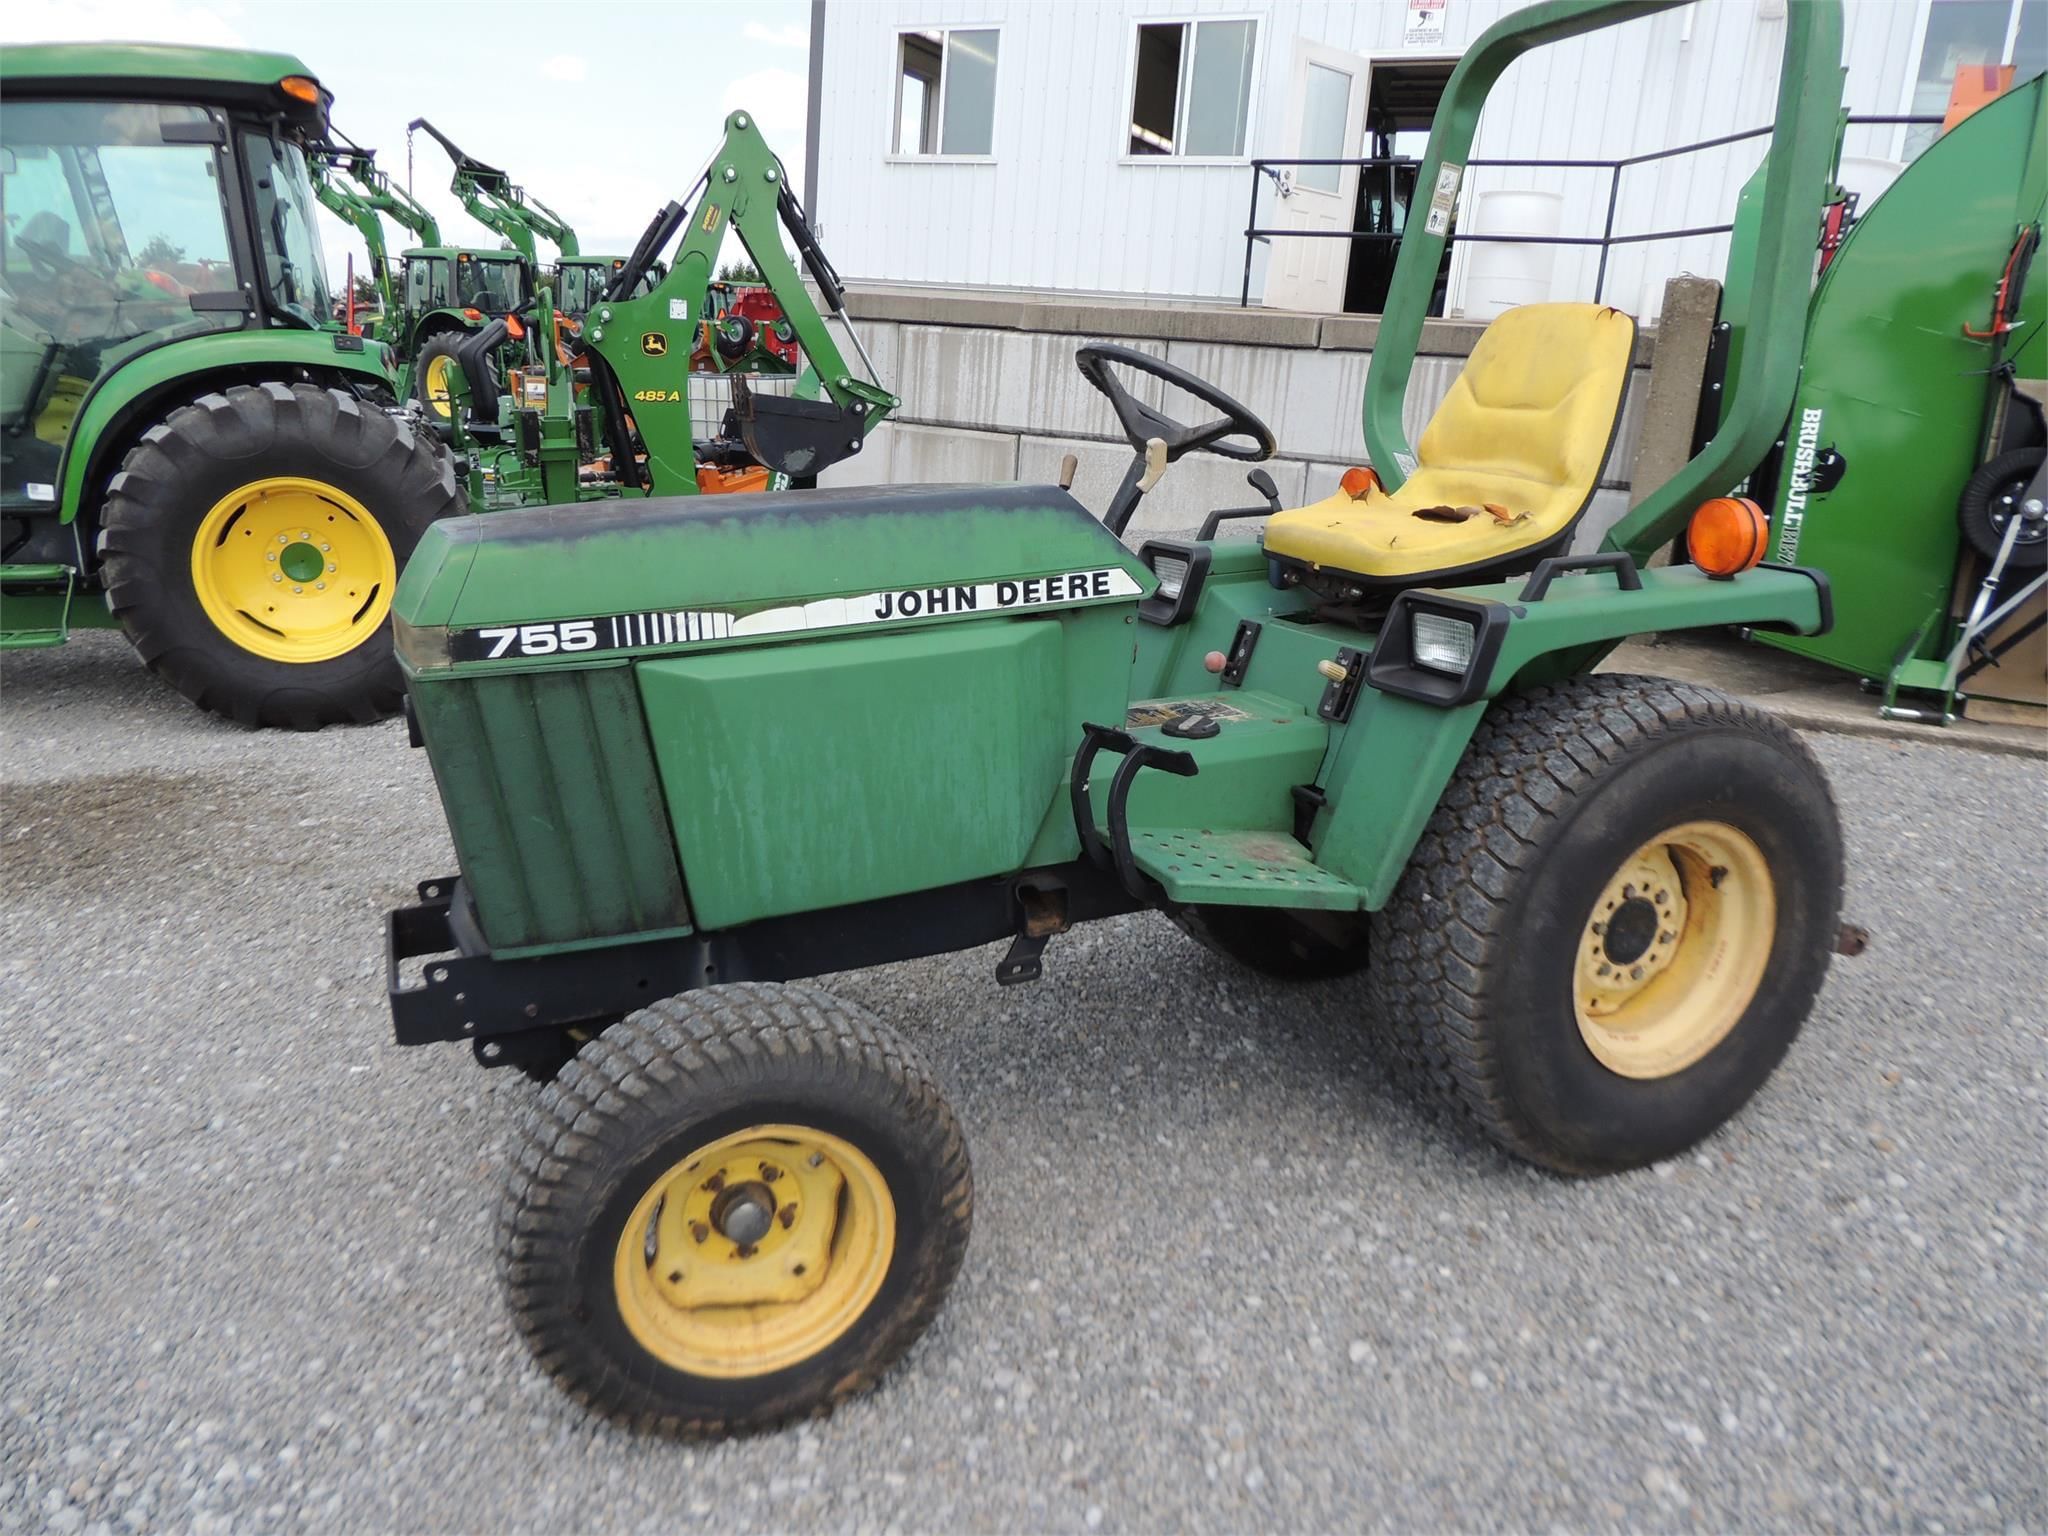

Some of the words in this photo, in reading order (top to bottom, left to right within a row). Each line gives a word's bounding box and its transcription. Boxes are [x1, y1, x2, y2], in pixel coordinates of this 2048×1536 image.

[875, 585, 977, 619] JOHN
[996, 571, 1111, 607] DEERE
[479, 621, 598, 658] 755
